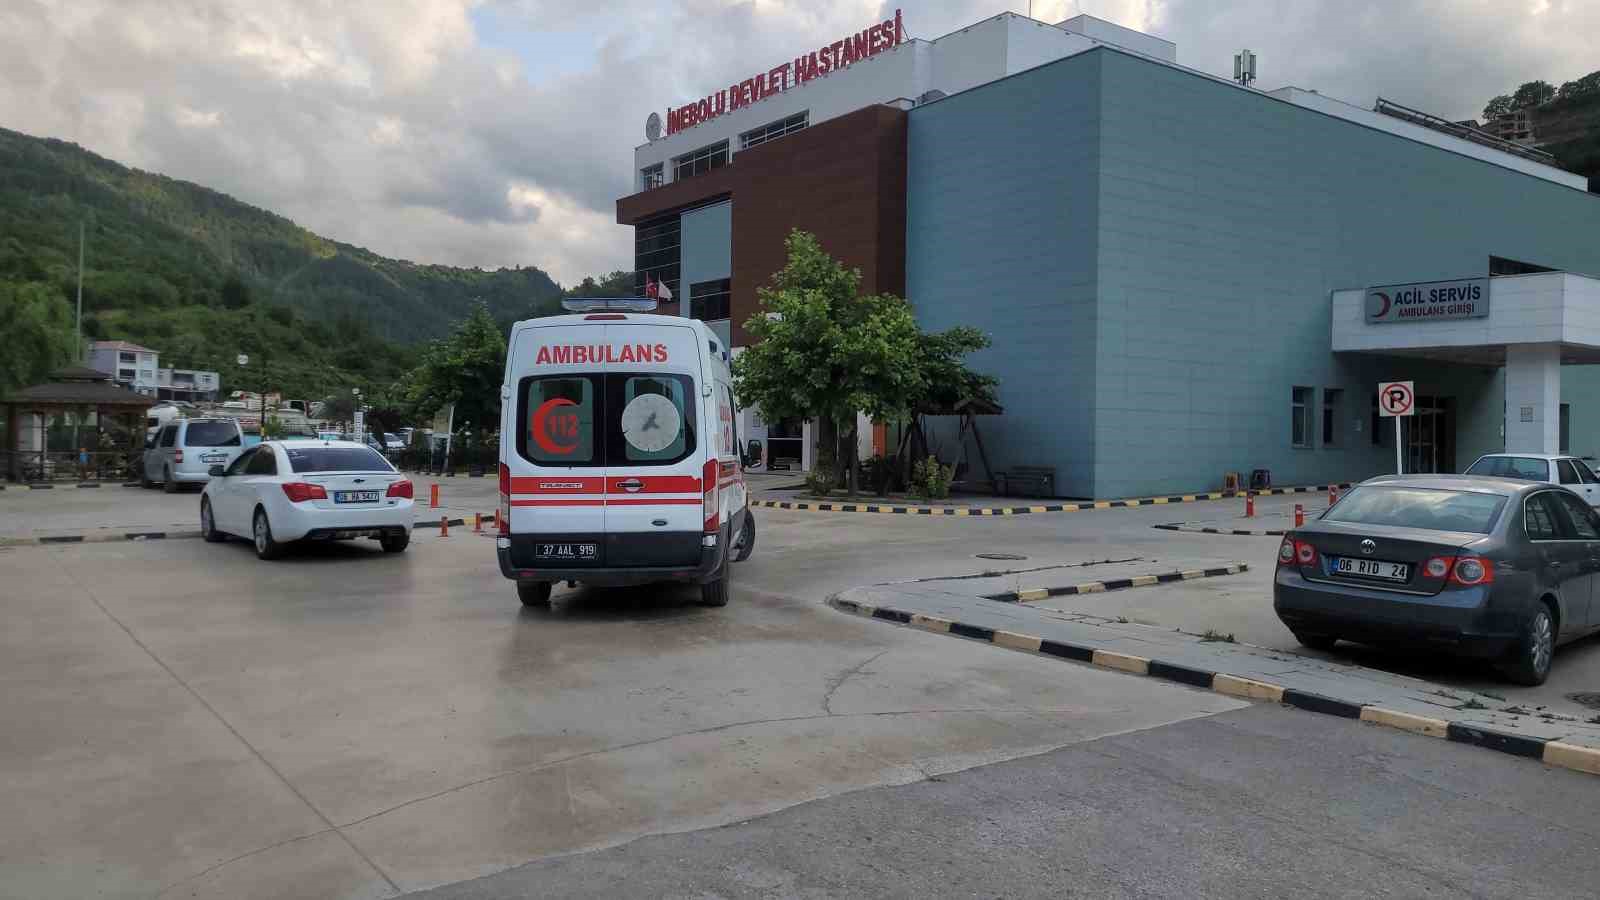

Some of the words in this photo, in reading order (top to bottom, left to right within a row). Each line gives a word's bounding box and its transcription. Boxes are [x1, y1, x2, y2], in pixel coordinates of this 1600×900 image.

[667, 89, 726, 136] İNEBOLU
[730, 63, 790, 112] DEVLET
[795, 8, 902, 87] HASTANESİ
[1394, 287, 1425, 305] ACİL
[1430, 283, 1481, 304] SERVİS
[1398, 306, 1444, 318] AMBULANS
[536, 344, 668, 364] AMBULANS
[1390, 390, 1405, 408] P
[549, 415, 578, 437] 112
[543, 545, 554, 555] 37
[558, 544, 574, 555] AAL
[579, 545, 594, 555] 919
[1339, 559, 1353, 571] 06
[1359, 560, 1380, 574] RID
[1391, 565, 1407, 577] 24
